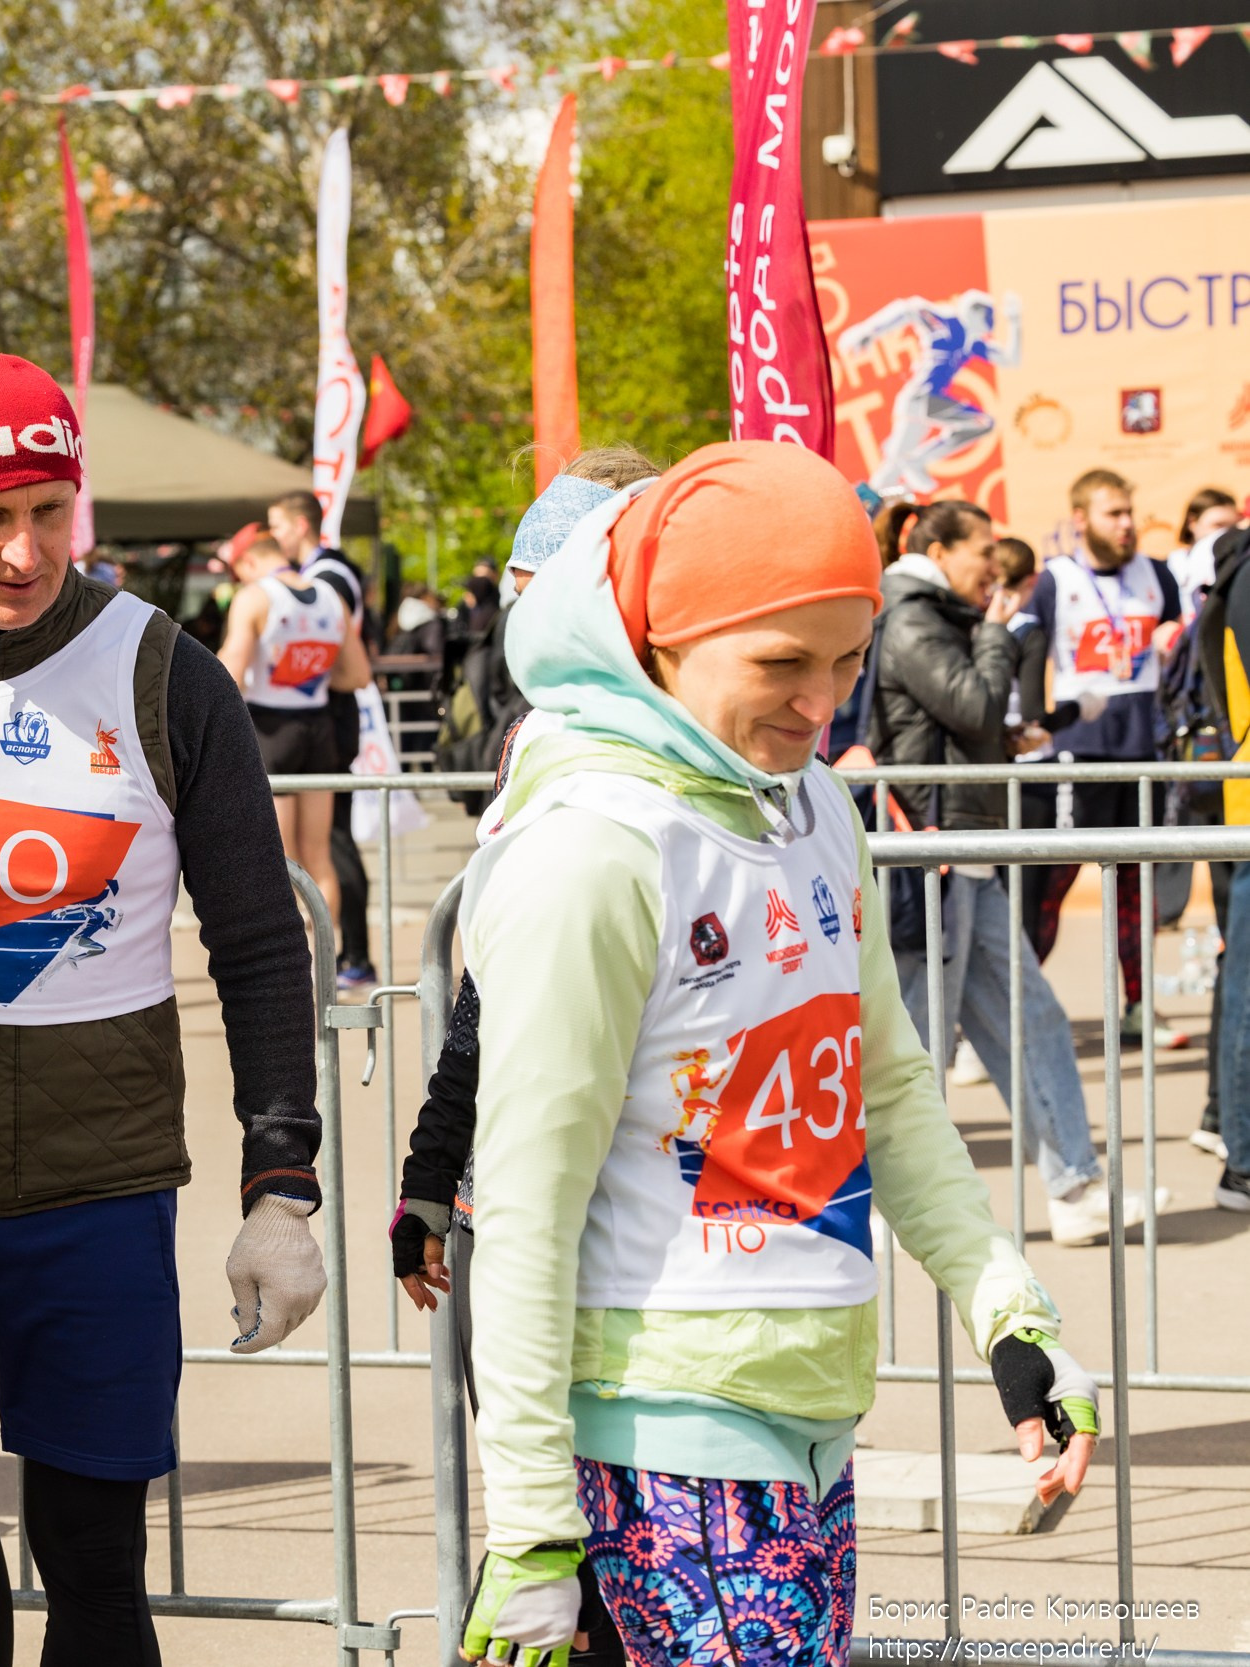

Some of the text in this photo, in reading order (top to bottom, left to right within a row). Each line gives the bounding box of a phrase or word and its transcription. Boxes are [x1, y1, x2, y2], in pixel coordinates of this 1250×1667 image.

[1060, 273, 1250, 334] БЫСТР
[5, 744, 47, 756] ВСПОРТЕ
[90, 767, 121, 776] ПОБЕДА!
[702, 1223, 766, 1254] ГТО
